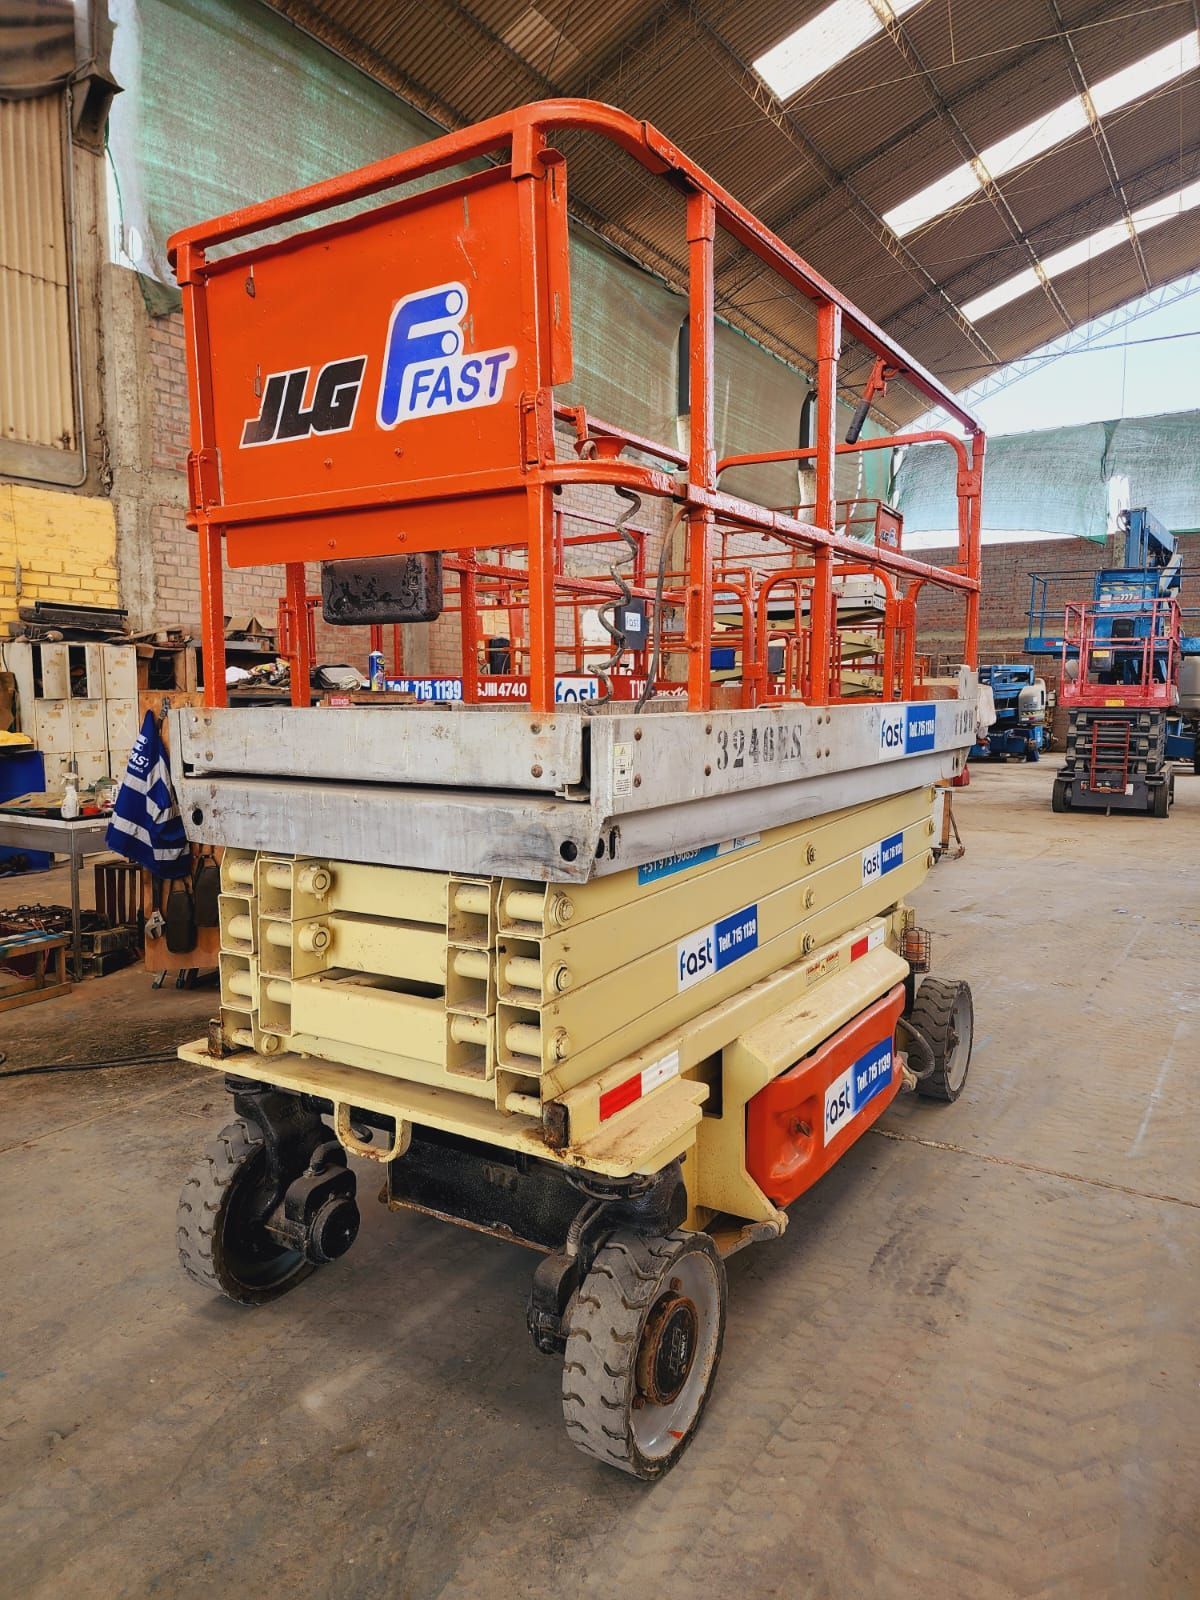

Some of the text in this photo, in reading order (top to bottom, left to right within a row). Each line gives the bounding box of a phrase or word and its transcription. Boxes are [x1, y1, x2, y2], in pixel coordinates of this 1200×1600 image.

[240, 356, 367, 447] JLG
[407, 351, 511, 412] FAST
[413, 680, 433, 699] 715
[434, 680, 462, 699] 1139
[498, 682, 527, 697] 4740
[881, 717, 903, 748] fast
[863, 850, 880, 878] fast
[679, 937, 713, 981] fast
[732, 926, 743, 946] 715
[743, 918, 757, 939] 1139
[825, 1080, 851, 1132] fast
[868, 1062, 878, 1084] 715
[878, 1052, 891, 1075] 1139
